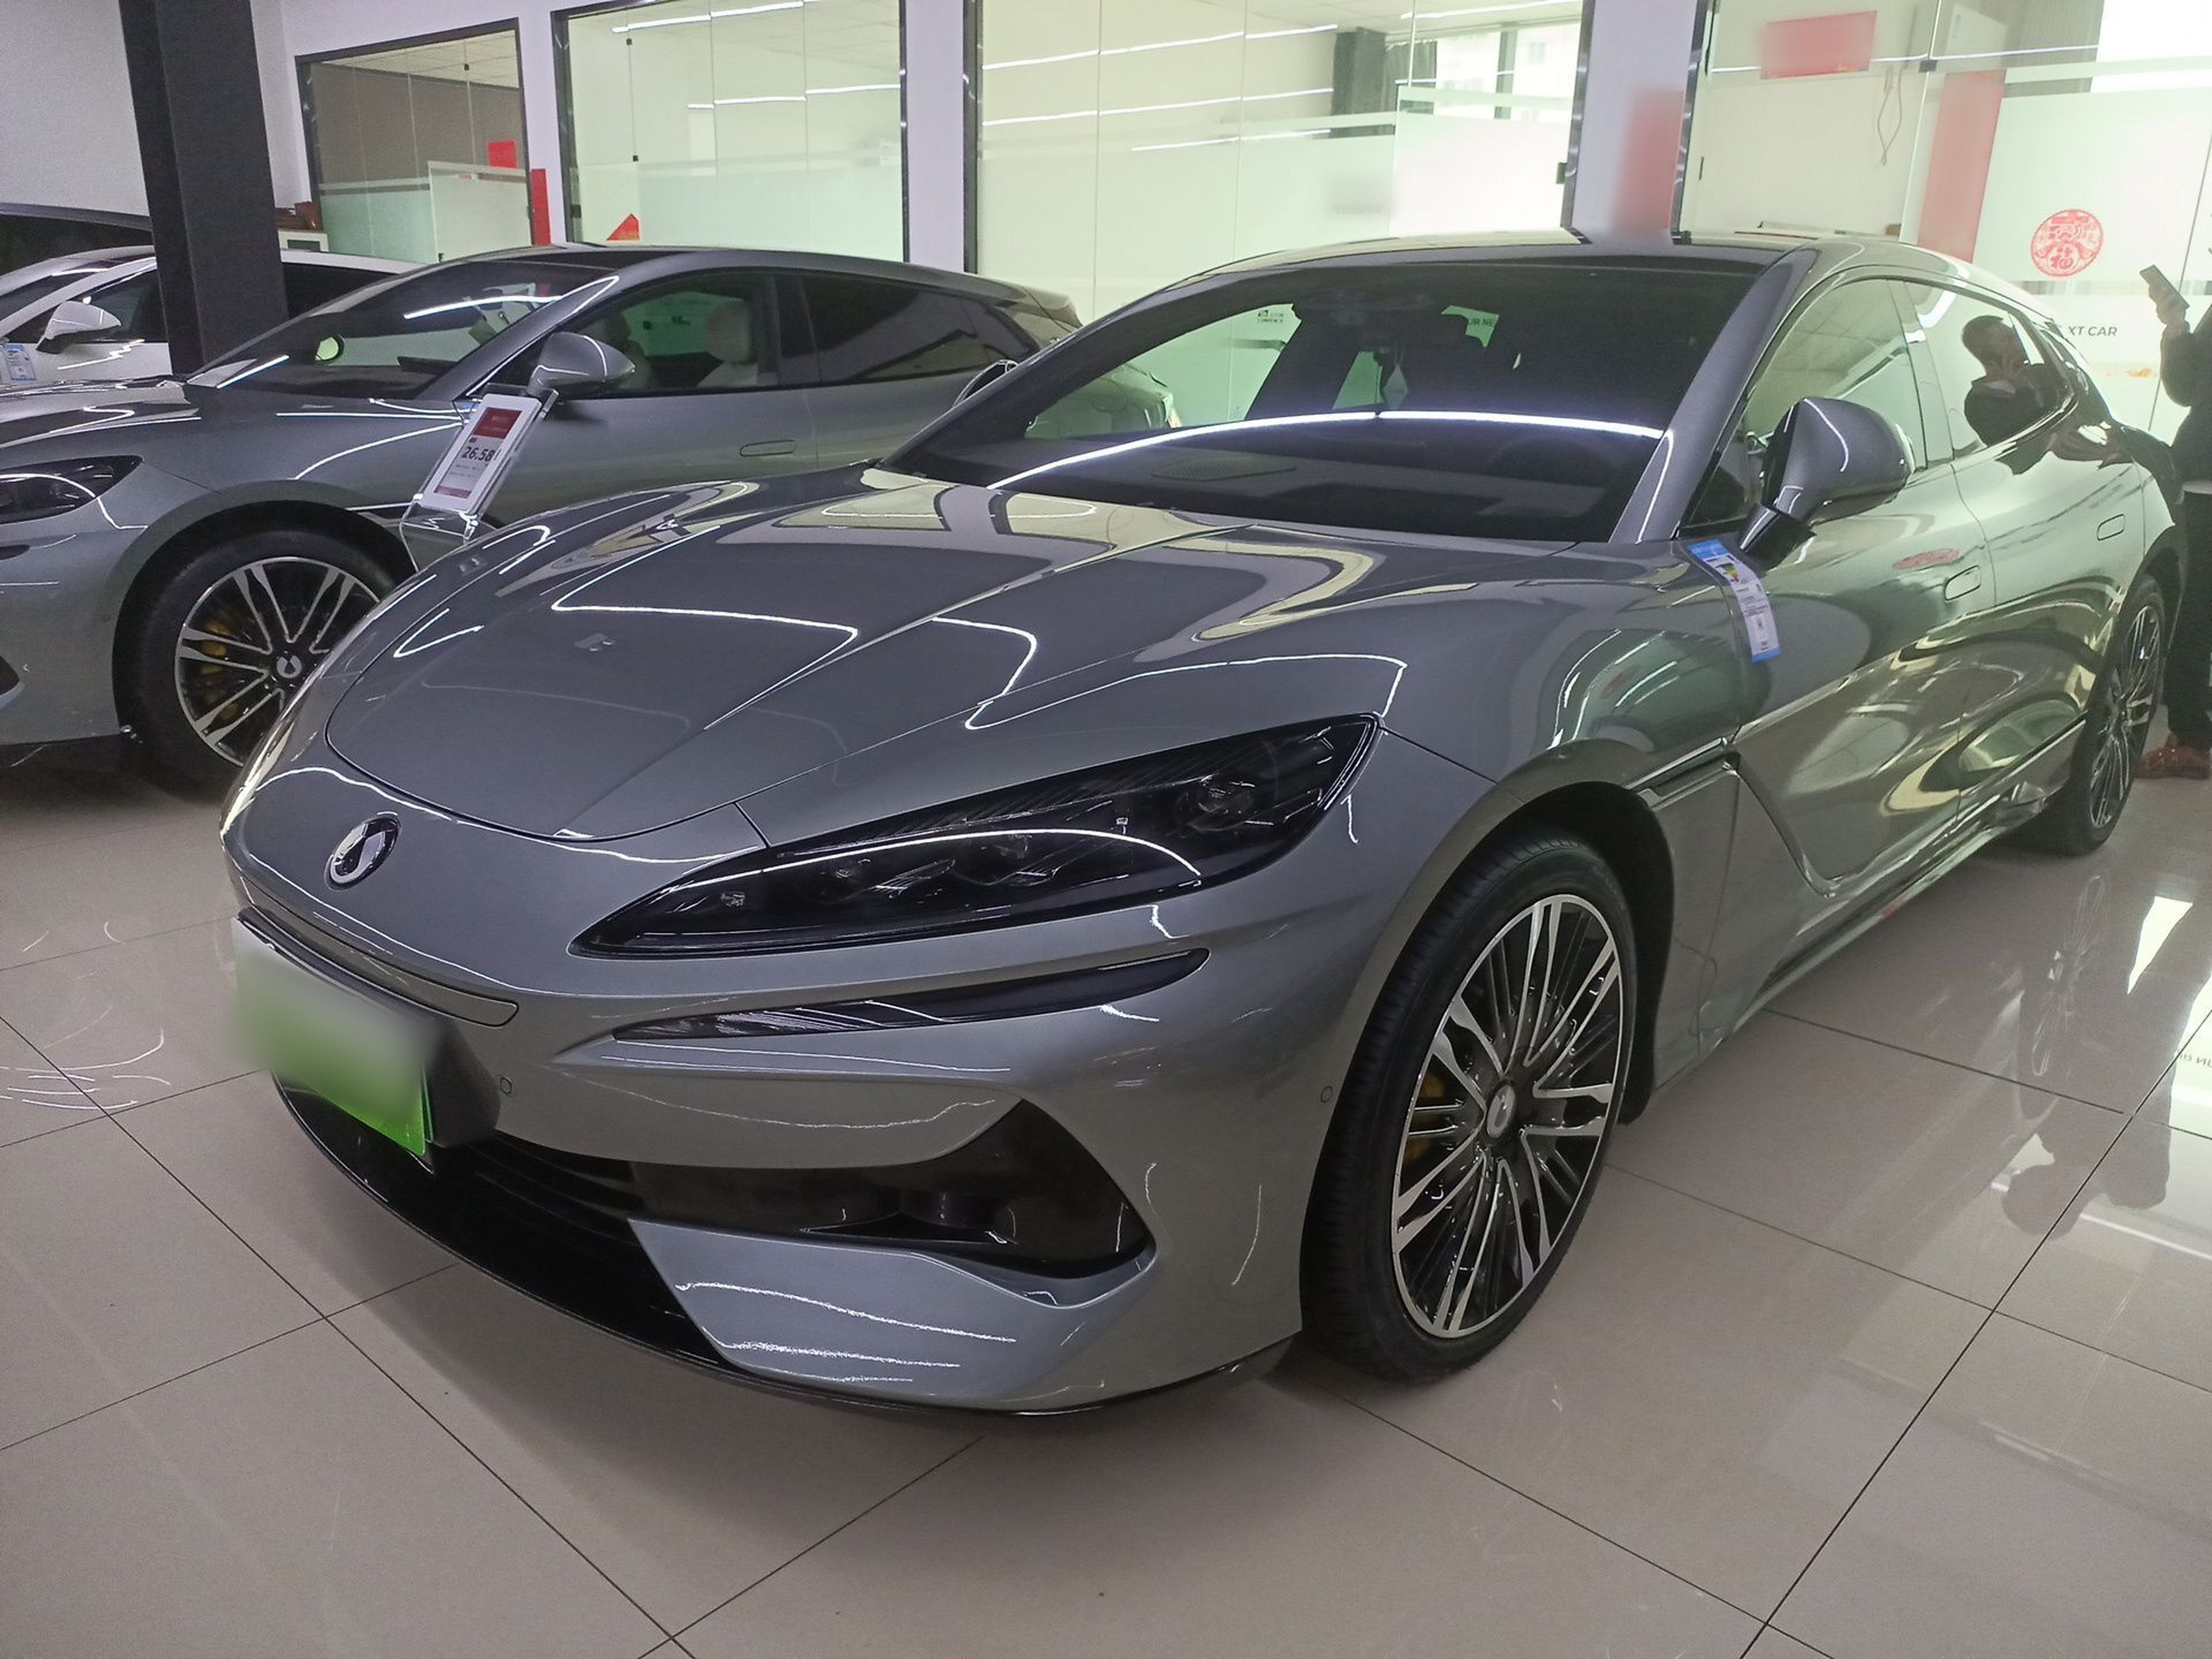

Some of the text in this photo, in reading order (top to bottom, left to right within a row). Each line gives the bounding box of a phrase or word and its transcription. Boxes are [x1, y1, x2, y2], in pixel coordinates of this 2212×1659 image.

[2067, 325, 2118, 336] XT CAR
[461, 446, 496, 461] 26.58
